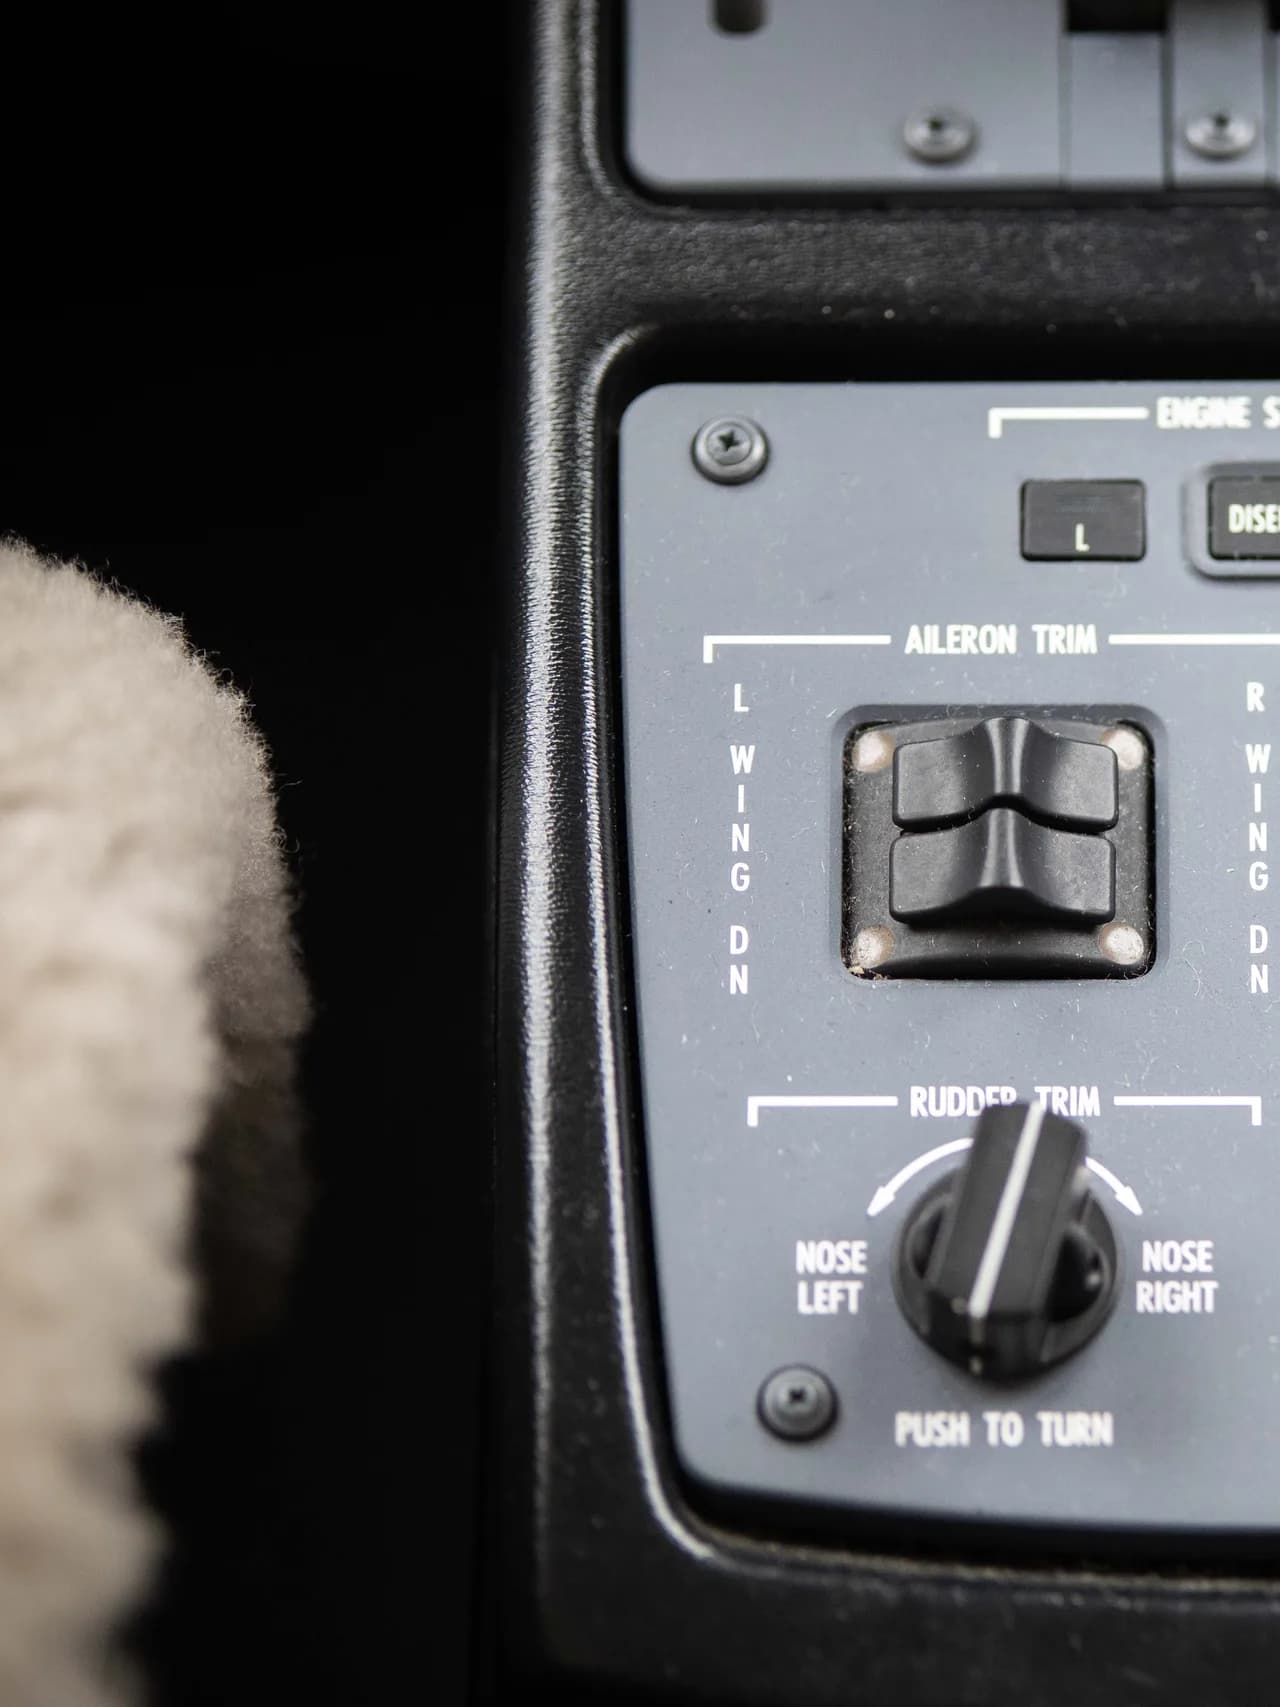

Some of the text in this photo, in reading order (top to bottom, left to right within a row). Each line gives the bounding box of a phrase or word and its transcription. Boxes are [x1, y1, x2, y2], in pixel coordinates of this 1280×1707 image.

[1156, 396, 1251, 429] ENGINE
[1075, 523, 1091, 553] L
[904, 623, 1098, 655] AILERON TRIM
[733, 683, 750, 713] L
[1246, 682, 1266, 712] R
[1034, 1085, 1101, 1117] TRIM
[795, 1240, 868, 1275] NOSE
[1142, 1240, 1214, 1273] NOSE
[796, 1281, 863, 1315] LEFT
[1135, 1280, 1219, 1314] RIGHT
[895, 1411, 1114, 1447] PUSH TO TURN
